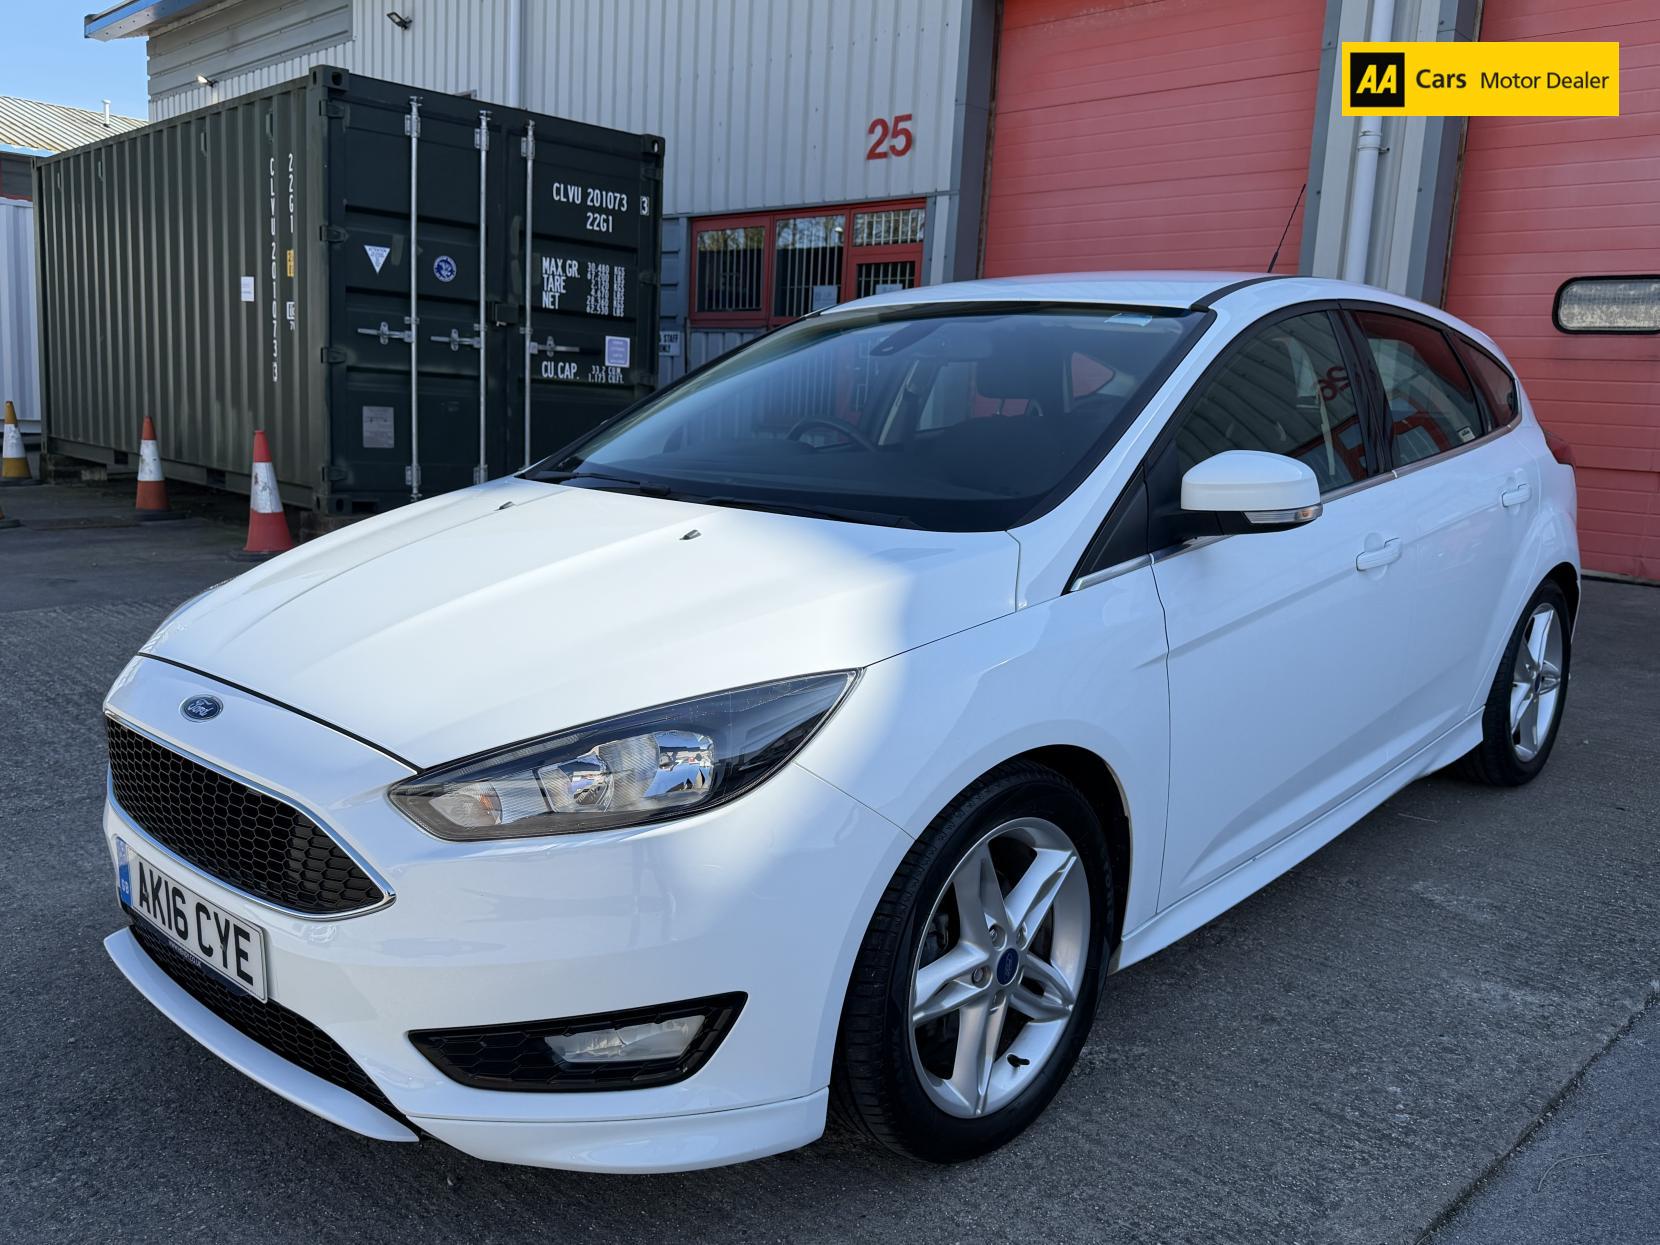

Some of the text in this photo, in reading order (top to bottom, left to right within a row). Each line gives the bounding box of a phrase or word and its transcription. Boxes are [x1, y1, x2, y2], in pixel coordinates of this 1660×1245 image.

[866, 113, 913, 160] 25
[552, 182, 649, 215] CLVU 201073 3
[586, 212, 612, 233] 22G1
[542, 274, 566, 293] TARE
[542, 291, 560, 309] NET
[139, 861, 253, 986] AK16 CYE
